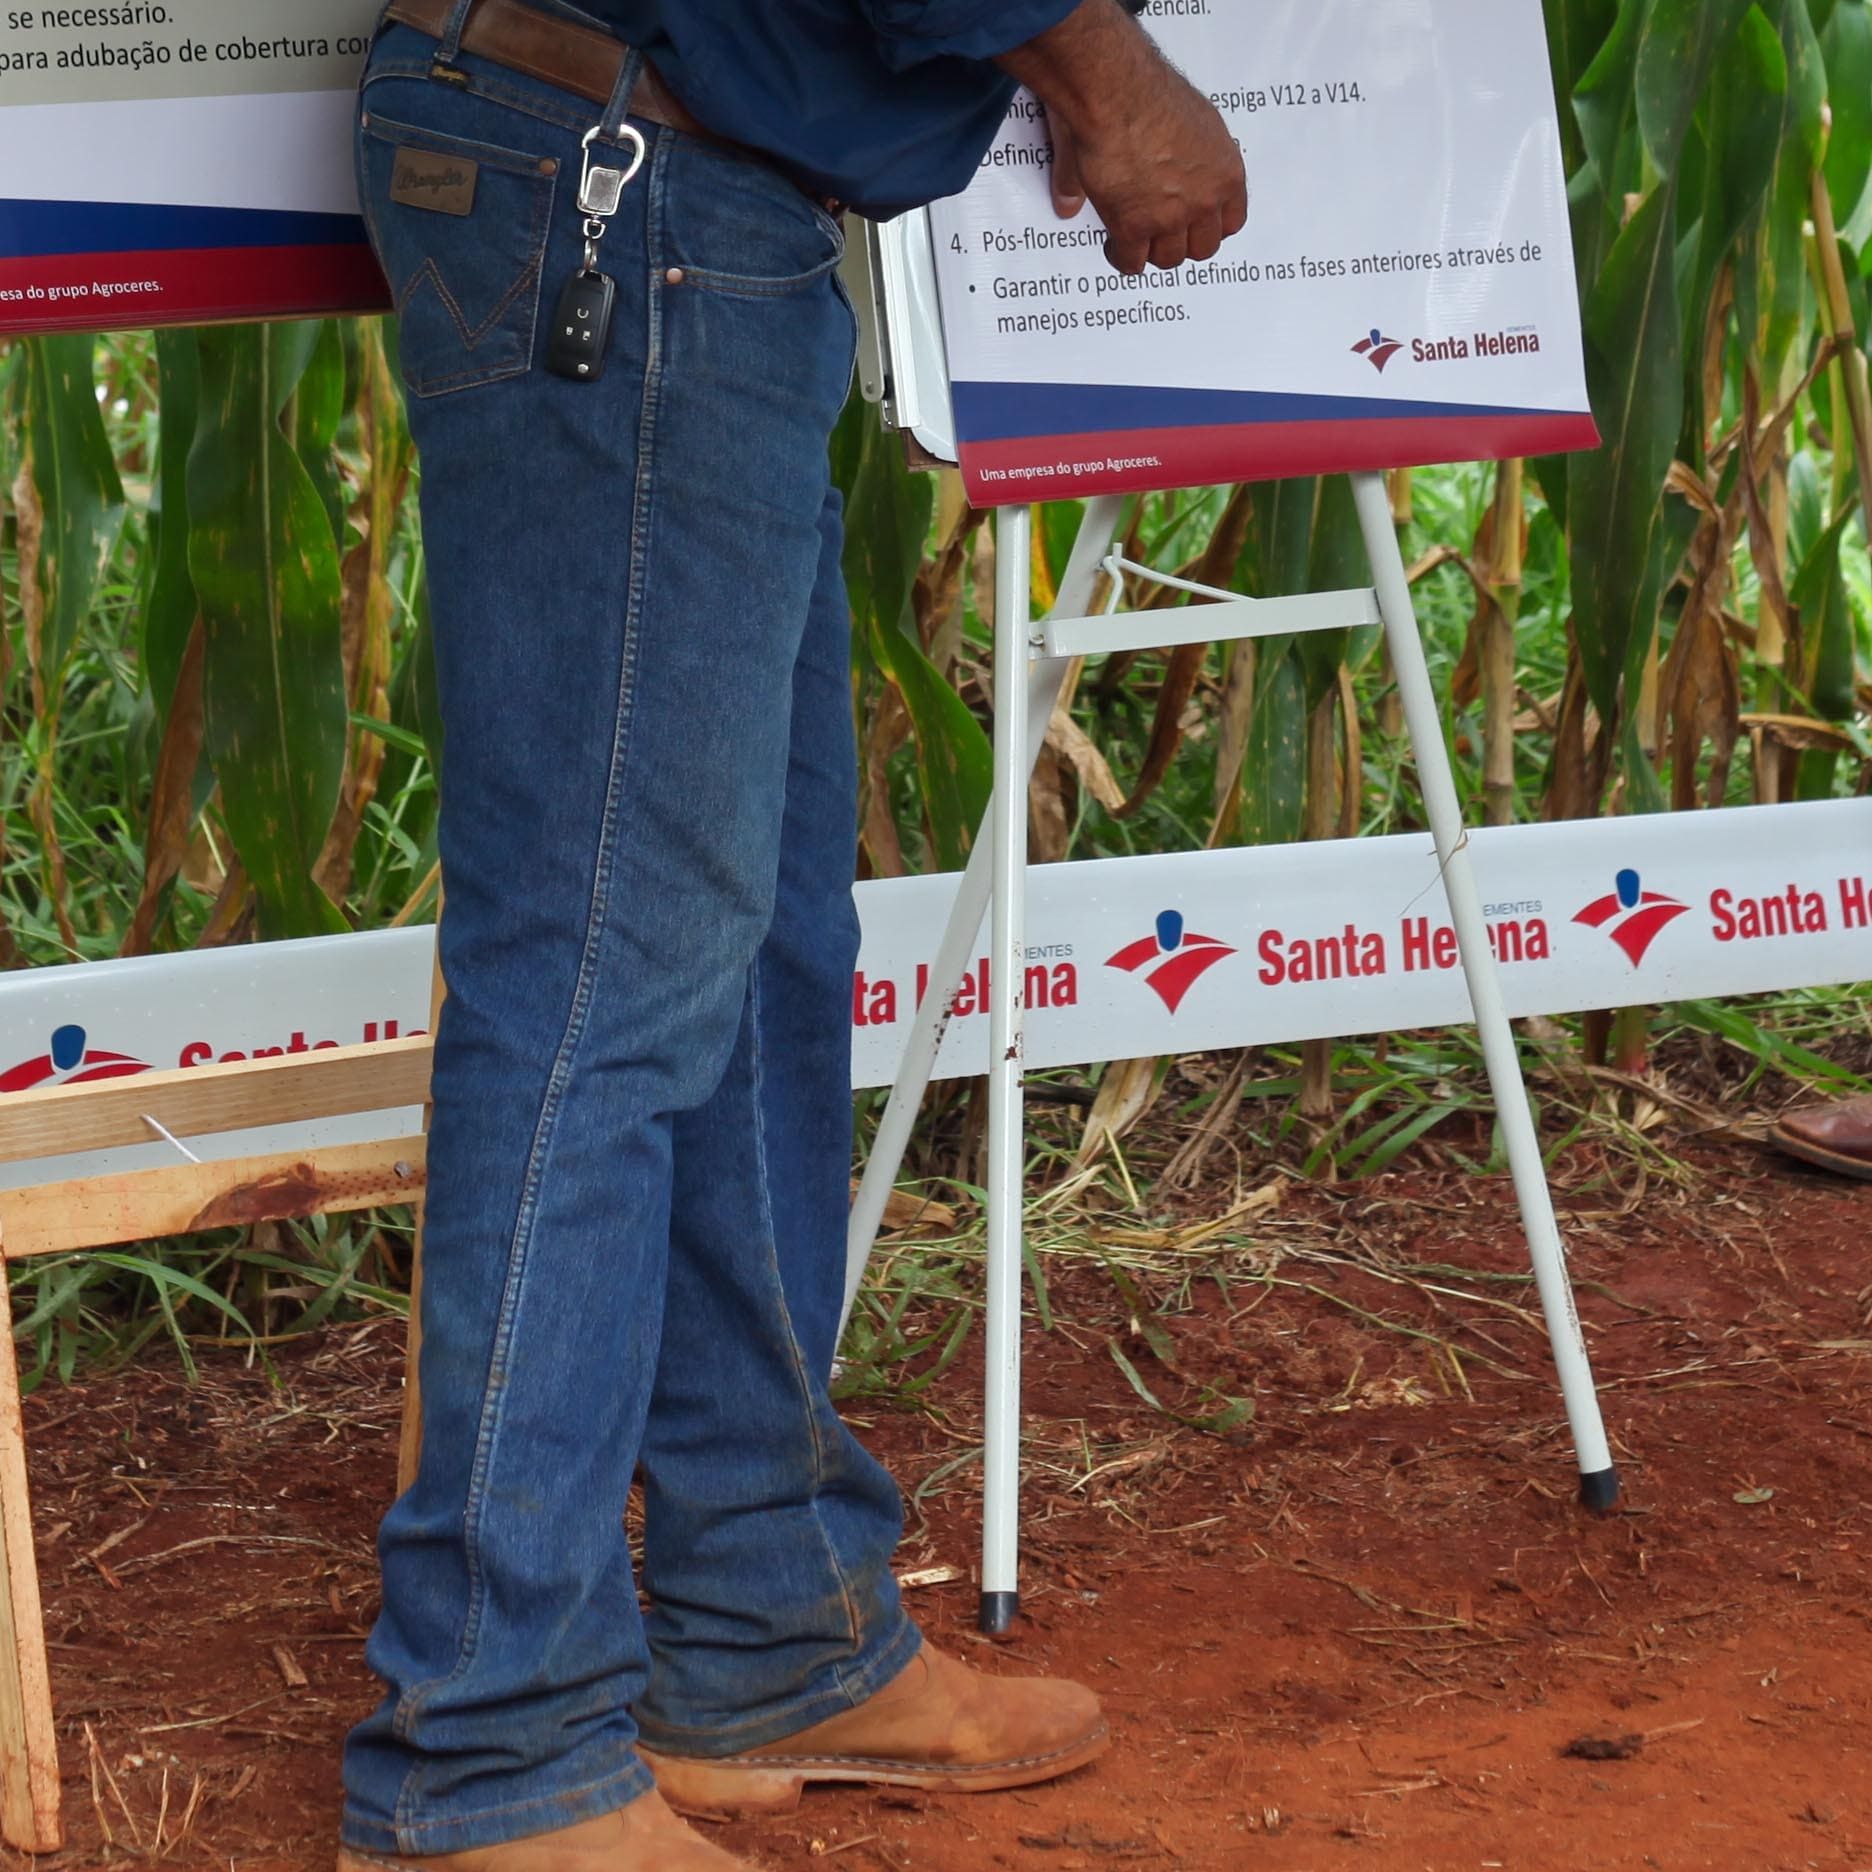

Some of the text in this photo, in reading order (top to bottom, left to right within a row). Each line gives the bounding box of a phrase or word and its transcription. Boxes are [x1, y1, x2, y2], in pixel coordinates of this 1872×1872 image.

[9, 12, 33, 29] se
[42, 1, 172, 27] necessário.
[57, 41, 170, 70] adubação
[179, 39, 207, 62] de
[216, 36, 328, 60] cobertura
[1209, 82, 1366, 113] espiga V12 a V14.
[950, 224, 1109, 255] 4. Pós-florescim
[994, 240, 1541, 298] Garantir o potencial definido nas fases anteriores através de
[27, 285, 44, 298] do
[48, 286, 88, 300] grupo
[93, 281, 163, 297] Agroceres.
[998, 300, 1190, 335] manejos específicos.
[1412, 332, 1539, 362] Santa Helena
[980, 456, 1161, 481] Uma empresa do grupo Agroceres.
[1483, 900, 1544, 918] EMENTES
[1709, 884, 1828, 941] Santa
[1258, 916, 1550, 986] Santa Hena
